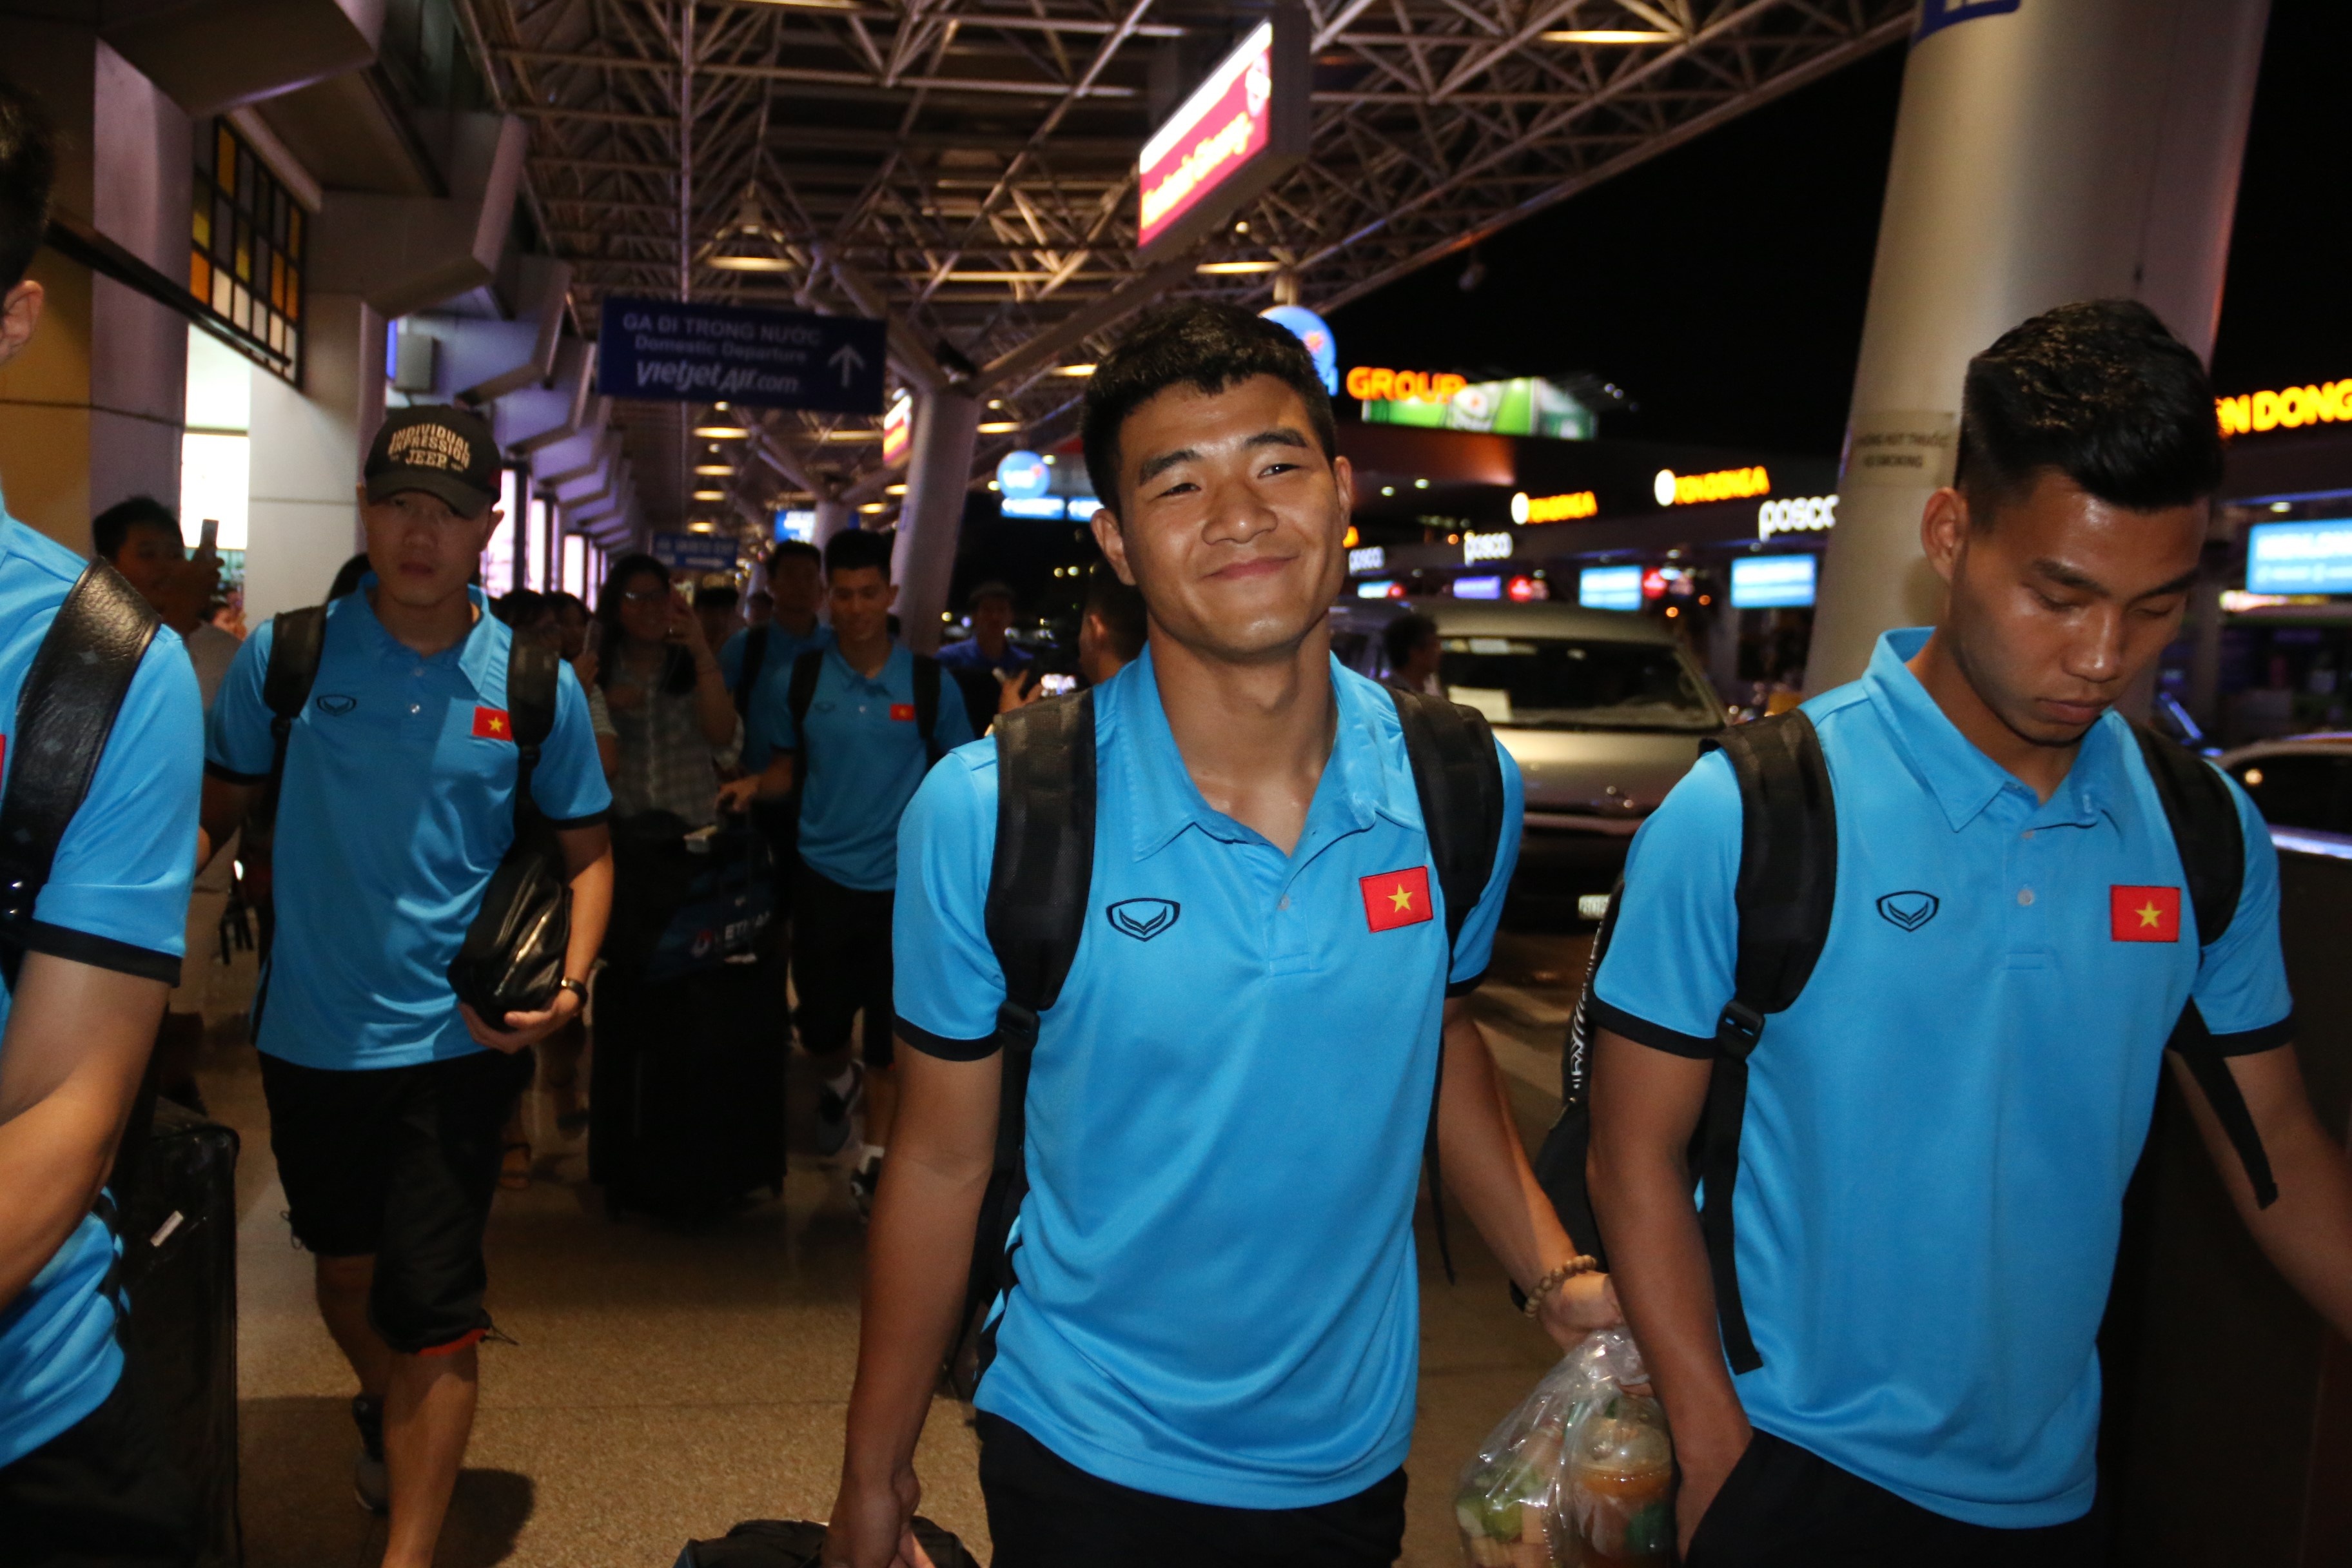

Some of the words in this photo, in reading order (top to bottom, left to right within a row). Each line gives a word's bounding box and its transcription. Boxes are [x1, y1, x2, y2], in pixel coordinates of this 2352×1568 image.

[622, 312, 652, 331] GA
[682, 316, 756, 341] TRONG
[634, 333, 717, 356] Domestic
[721, 340, 807, 364] Departure
[1347, 366, 1468, 403] GROUP
[391, 423, 470, 454] INDIVIDUAL
[406, 449, 447, 469] JEEP
